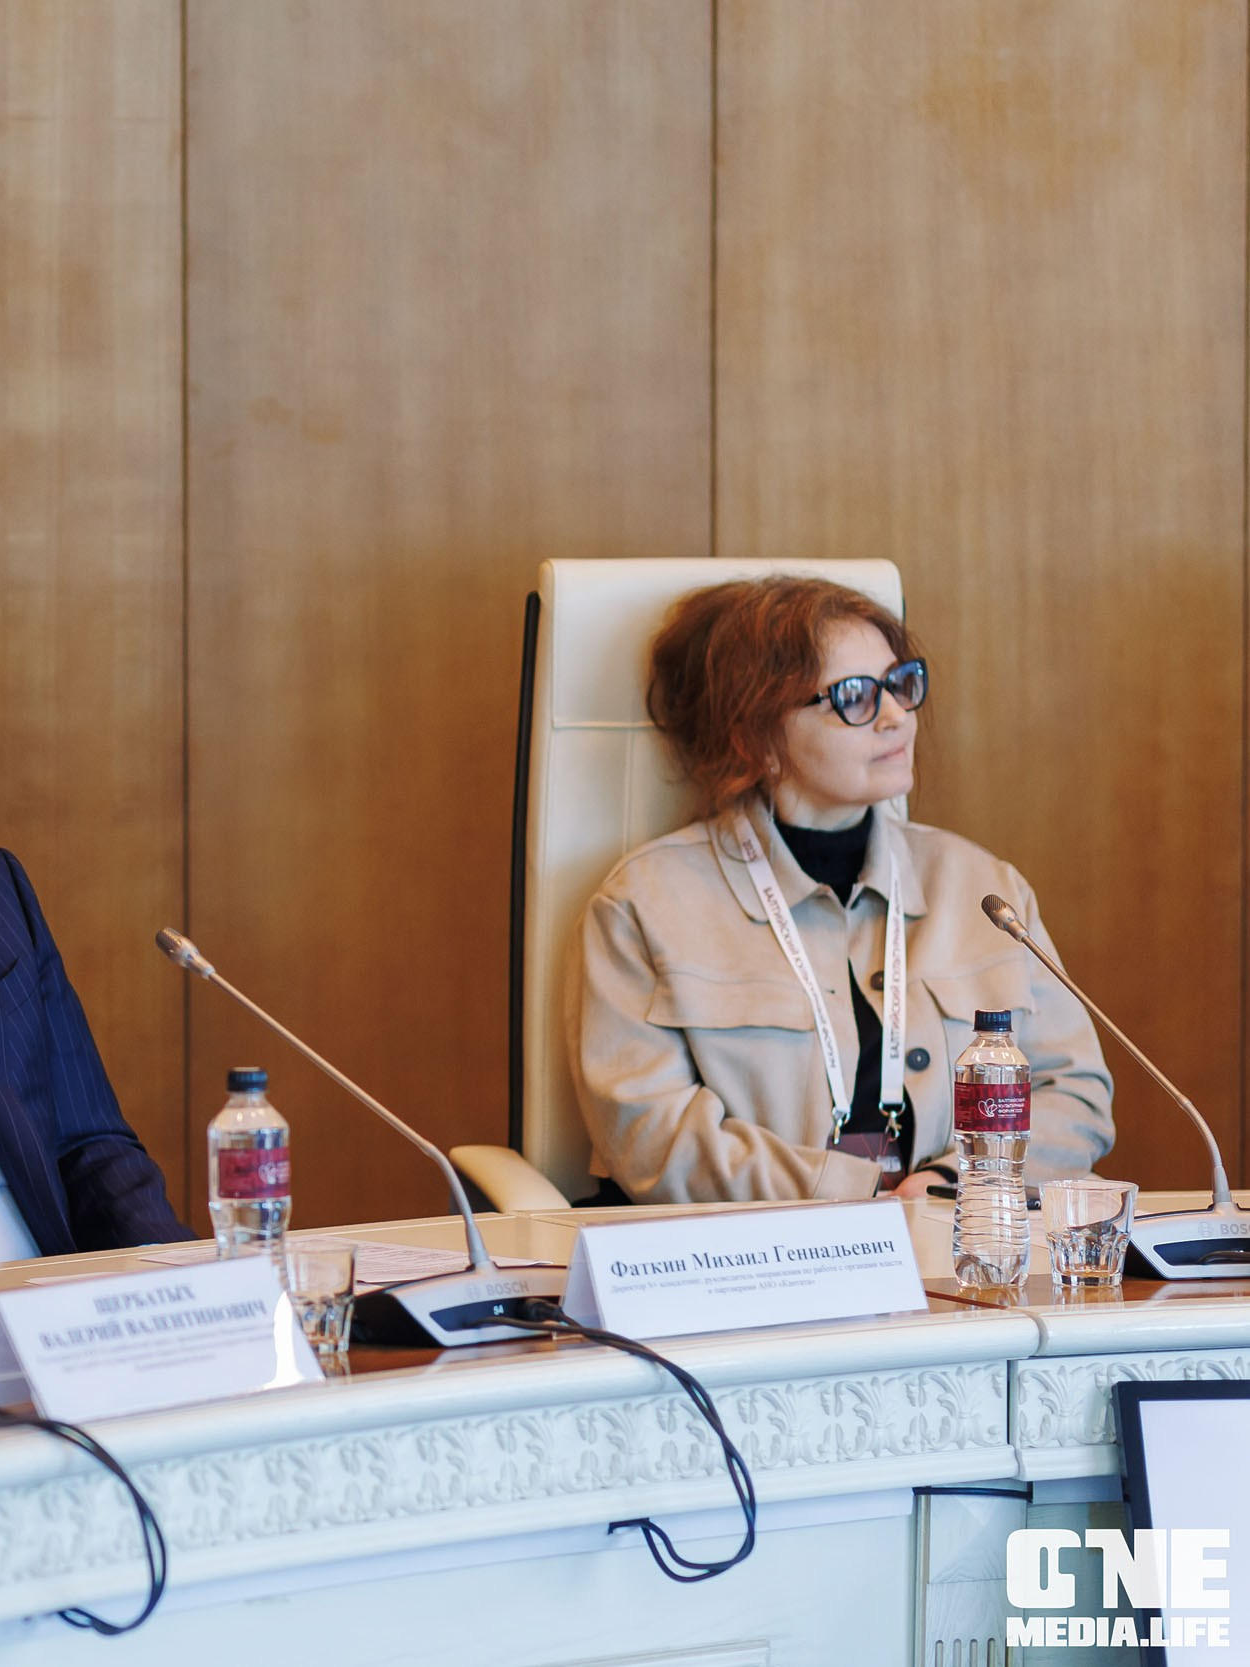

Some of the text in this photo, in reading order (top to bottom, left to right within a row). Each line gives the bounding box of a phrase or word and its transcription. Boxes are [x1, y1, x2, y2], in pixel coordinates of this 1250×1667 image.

[610, 1240, 896, 1277] Фаткин Михаил Геннадьевич
[486, 1281, 530, 1297] BOSCH
[40, 1300, 269, 1347] ВАЛЕРИЙ ВАЛЕНТИНОВИЧ
